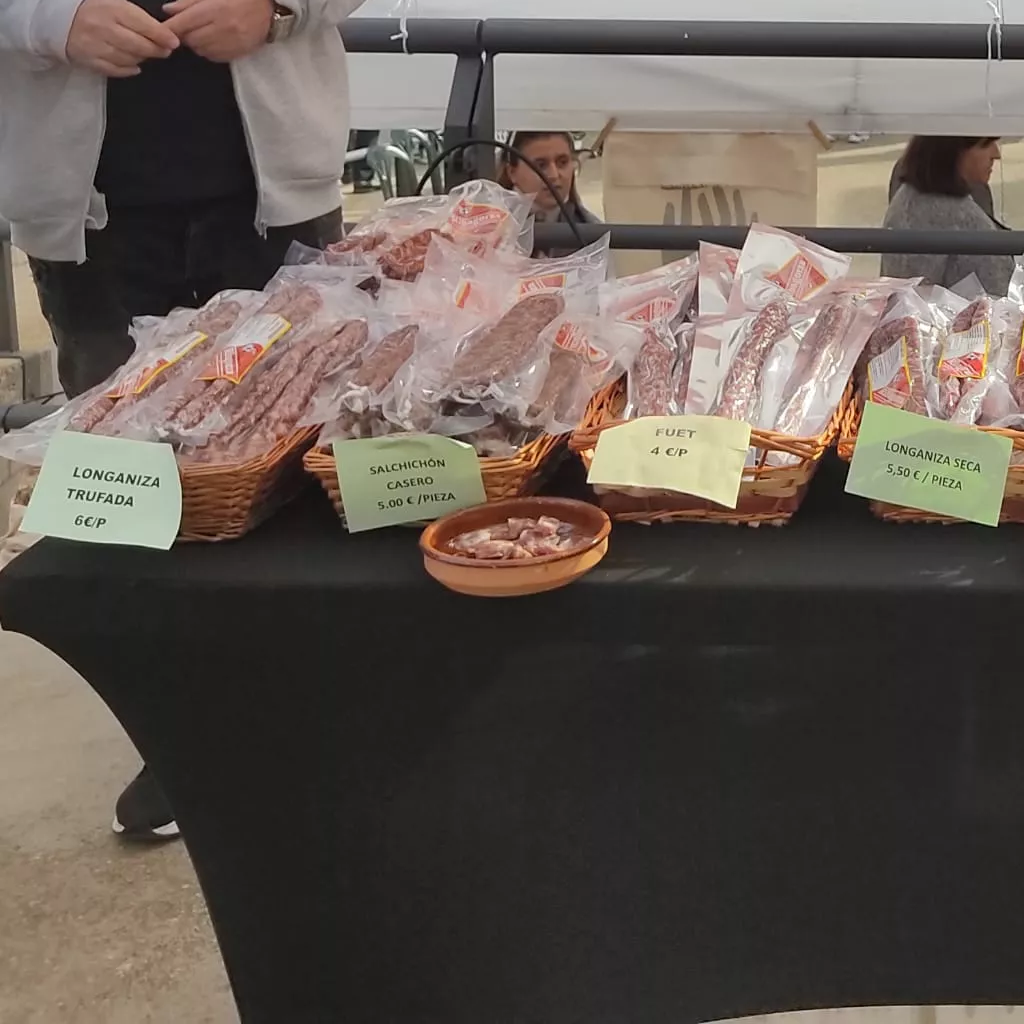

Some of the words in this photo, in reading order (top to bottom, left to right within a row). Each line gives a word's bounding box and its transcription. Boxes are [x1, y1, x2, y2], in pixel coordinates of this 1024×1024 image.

[655, 428, 696, 439] FUET
[650, 447, 660, 456] 4
[665, 447, 688, 457] €/P
[885, 440, 951, 466] LONGANIZA
[953, 457, 981, 473] SECA
[369, 458, 446, 475] SALCHICHÓN
[72, 466, 160, 488] LONGANIZA
[386, 476, 434, 490] CASERO
[886, 463, 911, 478] 5,50
[913, 470, 921, 480] €
[921, 472, 930, 484] /
[931, 474, 962, 491] PIEZA
[66, 488, 134, 507] TRUFADA
[377, 497, 403, 510] 5.00
[406, 496, 415, 505] €
[74, 514, 106, 529] 6€/P
